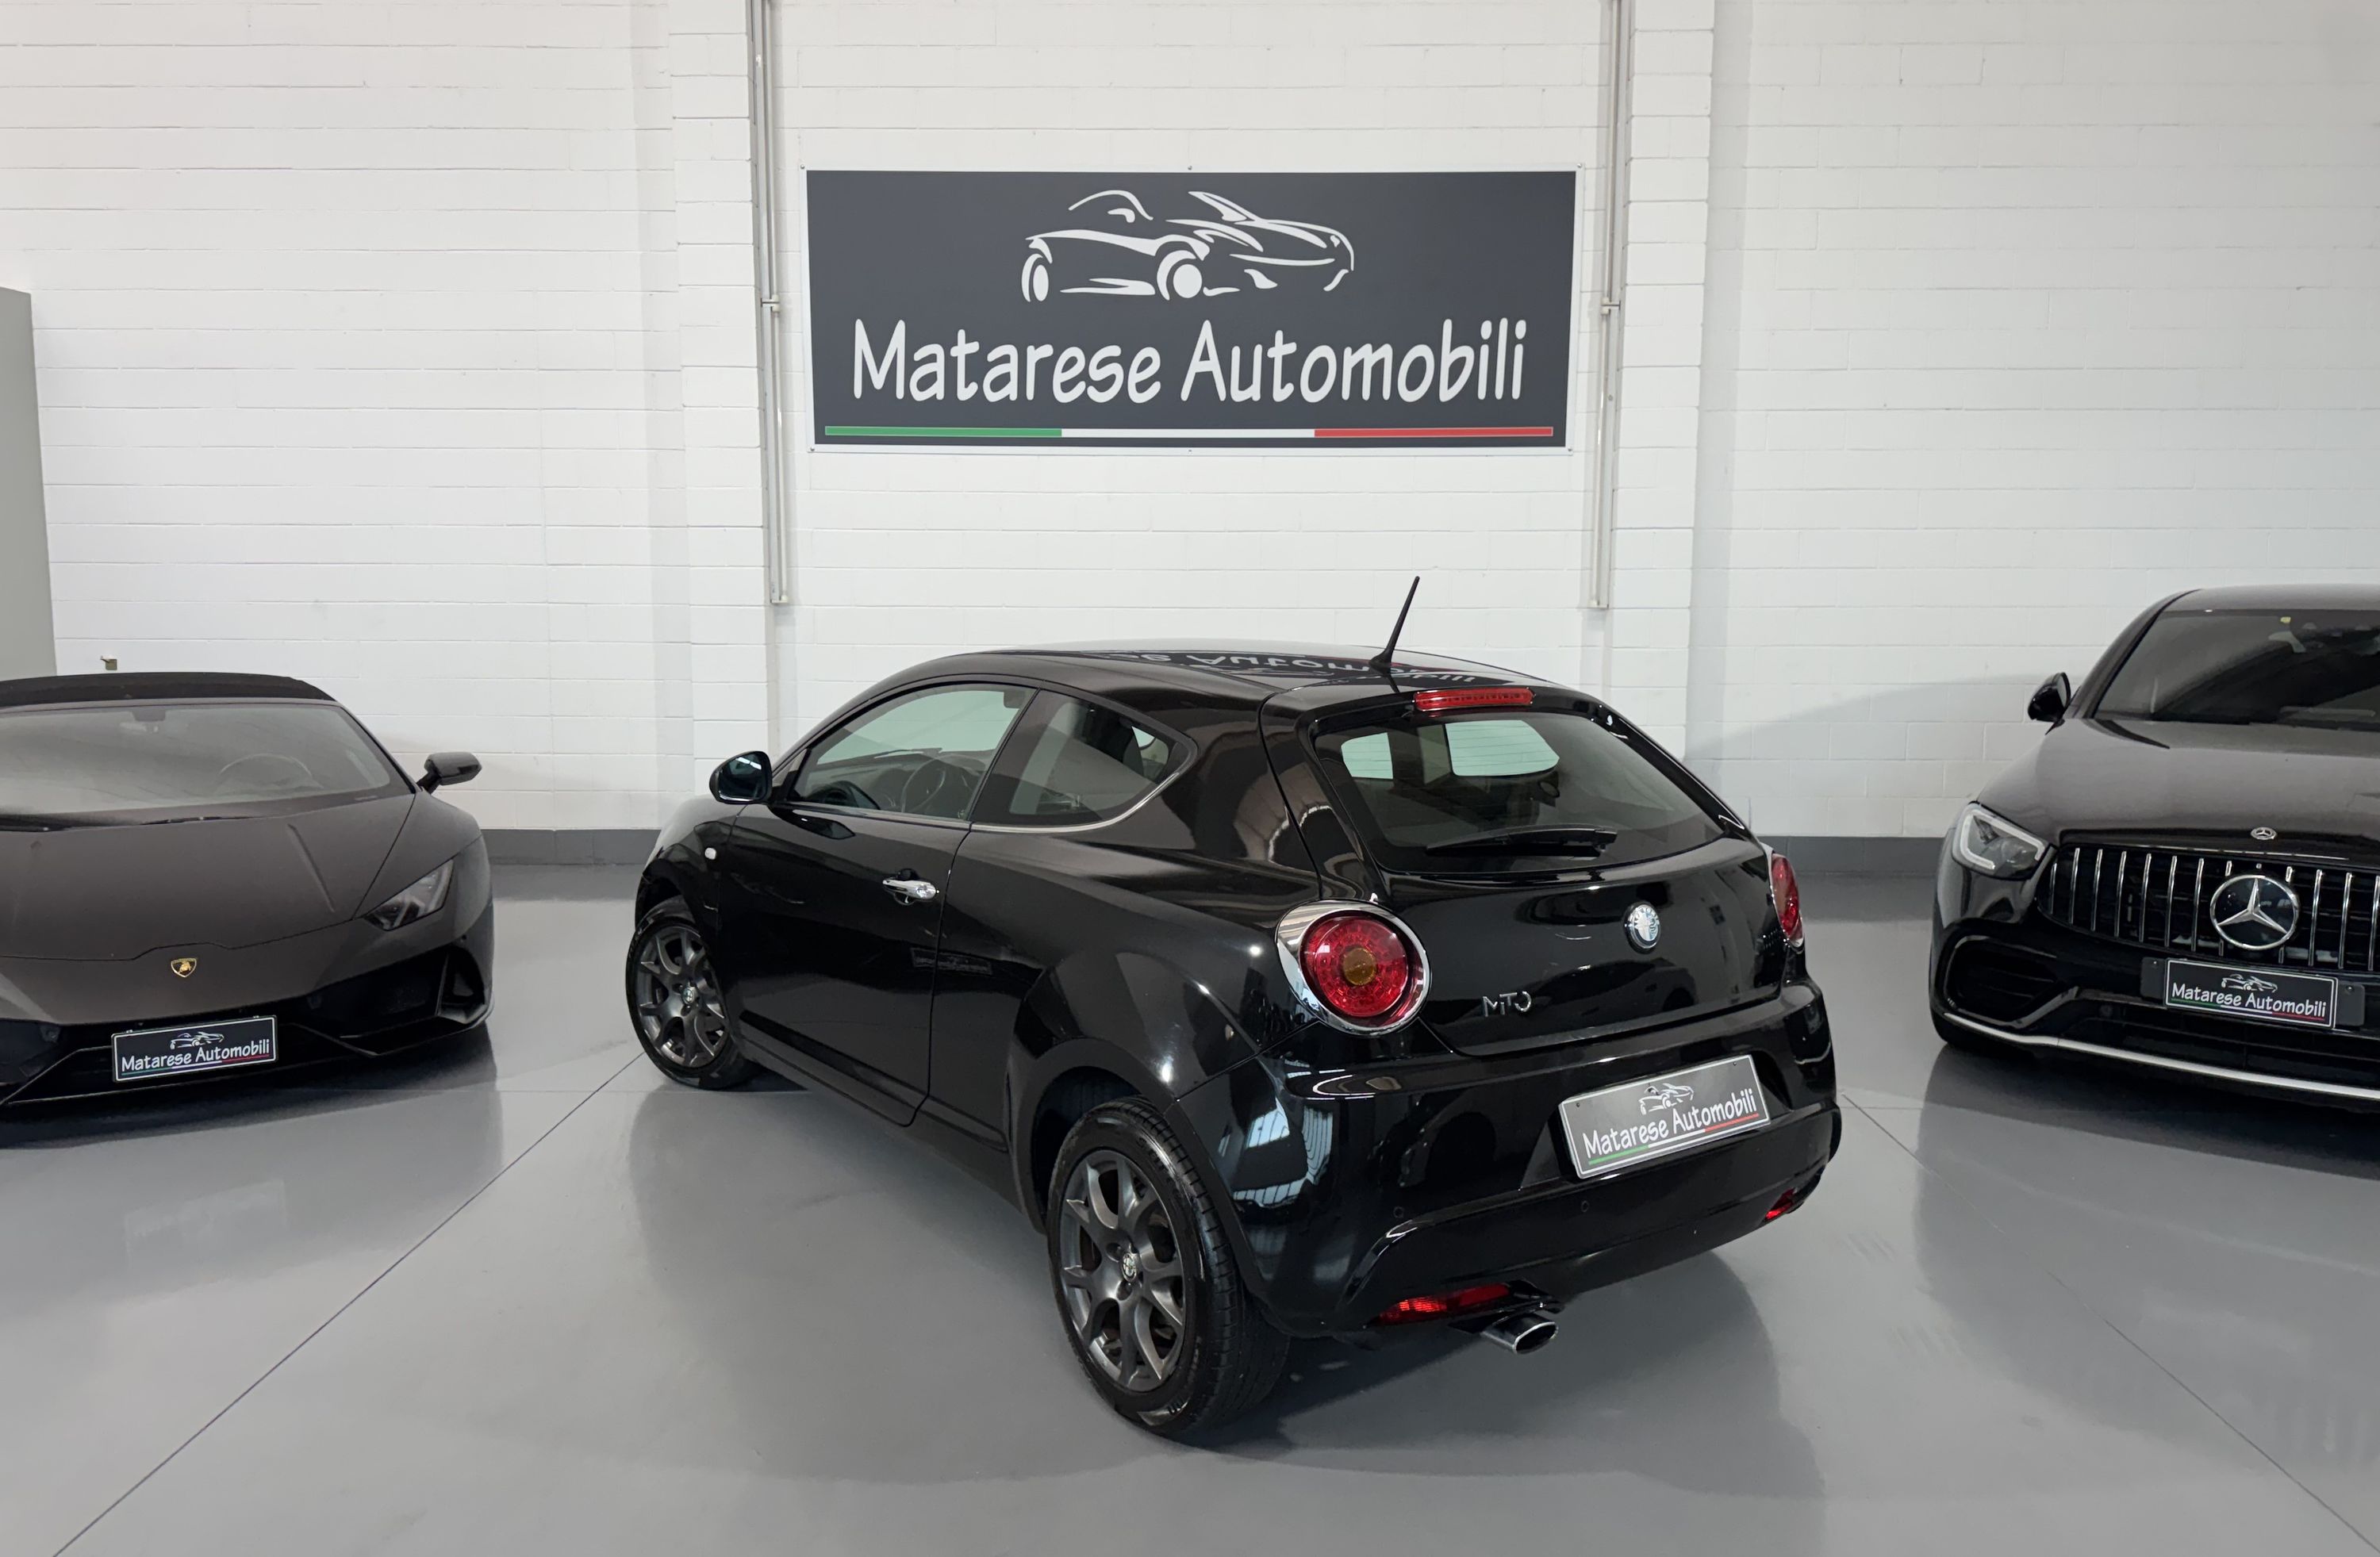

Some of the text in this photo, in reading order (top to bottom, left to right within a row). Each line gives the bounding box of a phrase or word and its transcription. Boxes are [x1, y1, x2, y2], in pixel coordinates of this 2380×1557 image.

[854, 318, 1527, 403] Matarese Automobili
[2171, 982, 2326, 1018] Matarese Automobili
[121, 1039, 270, 1072] Matarese Automobili
[1582, 1087, 1757, 1159] Matarese Automobili
